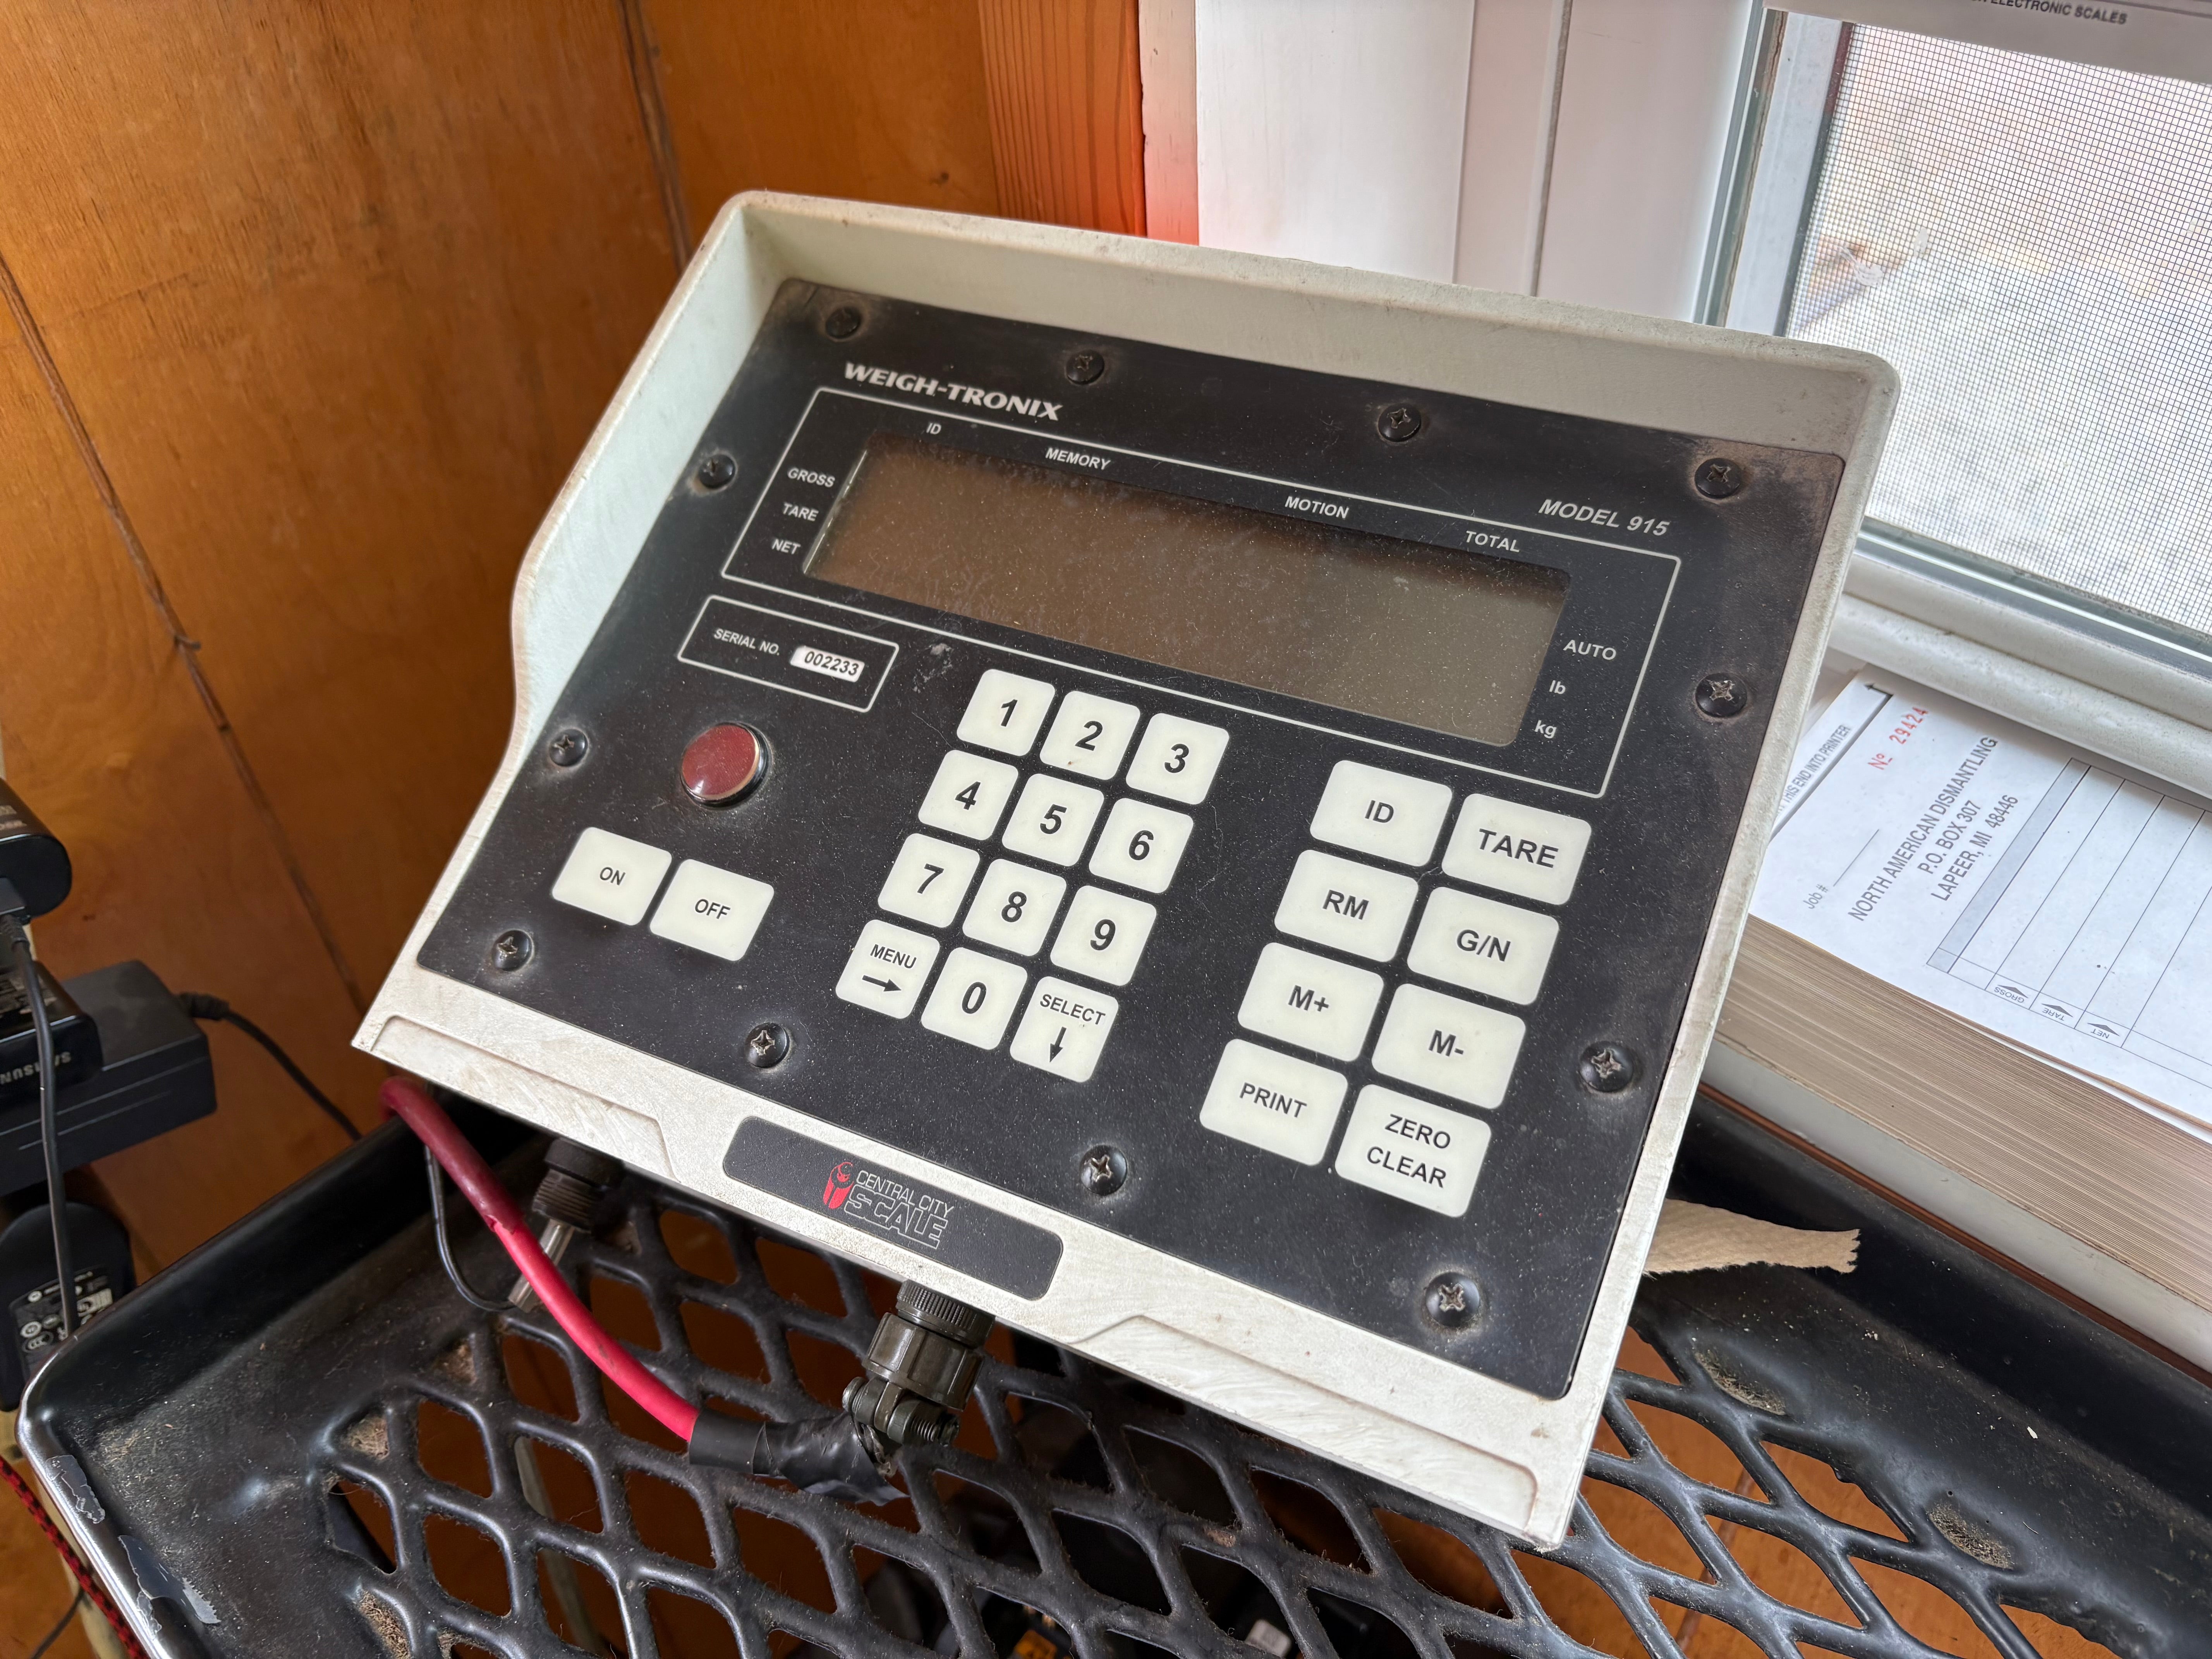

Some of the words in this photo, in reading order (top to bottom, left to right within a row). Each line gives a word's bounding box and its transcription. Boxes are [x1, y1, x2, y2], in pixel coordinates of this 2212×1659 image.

[2074, 4, 2128, 24] SCALES
[845, 362, 1063, 421] WEIGH-TRONIX
[926, 422, 942, 435] ID
[1046, 447, 1111, 470] MEMORY
[788, 467, 836, 488] GROSS
[782, 503, 819, 522] TARE
[1285, 496, 1349, 519] MOTION
[1537, 499, 1620, 527] MODEL
[1627, 516, 1670, 537] 915
[772, 539, 801, 555] NET
[1465, 531, 1520, 553] TOTAL
[714, 629, 756, 649] SERIAL
[759, 641, 780, 656] NO.
[1563, 639, 1617, 660] AUTO
[804, 651, 859, 676] 002233
[1549, 680, 1566, 695] lb
[1000, 699, 1018, 727] 1
[1889, 706, 1929, 745] 29424
[1075, 721, 1103, 750] 2
[1534, 720, 1556, 738] kg
[1164, 744, 1189, 773] 3
[1783, 785, 1799, 803] THIS
[1792, 769, 1811, 787] END
[1804, 753, 1826, 773] INTO
[1819, 725, 1851, 756] PRINTER
[955, 781, 981, 810] 4
[1039, 804, 1067, 834] 5
[1364, 800, 1394, 824] ID
[1848, 876, 1893, 921] NORTH
[1883, 814, 1939, 878] AMERICAN
[1929, 737, 1998, 822] DISMANTLING
[1918, 851, 1947, 874] P.O.
[1936, 821, 1967, 850] BOX
[1957, 800, 1981, 823] 307
[1128, 830, 1154, 860] 6
[1478, 828, 1559, 868] TARE
[1931, 850, 1984, 901] LAPEER,
[1969, 831, 1992, 849] MI
[1984, 795, 2018, 829] 48446
[599, 867, 626, 885] ON
[917, 864, 943, 893] 7
[694, 898, 730, 919] OFF
[1001, 891, 1027, 922] 8
[1322, 889, 1369, 921] RM
[1803, 890, 1823, 909] Job
[1090, 919, 1116, 950] 9
[1456, 929, 1511, 962] G/N
[870, 944, 917, 970] MENU
[962, 982, 987, 1014] 0
[1288, 985, 1329, 1013] M+
[1994, 986, 2025, 1003] GROSS
[1040, 994, 1105, 1025] SELECT
[2042, 1008, 2064, 1021] TARE
[1428, 1029, 1464, 1059] M-
[2091, 1028, 2110, 1039] NET
[0, 1052, 71, 1085] SSUN
[1239, 1082, 1307, 1118] PRINT
[1385, 1114, 1451, 1149] ZERO
[1367, 1146, 1446, 1188] CLEAR
[856, 1170, 915, 1207] CENTRAL
[919, 1194, 954, 1218] CITY
[844, 1184, 948, 1249] SCALE
